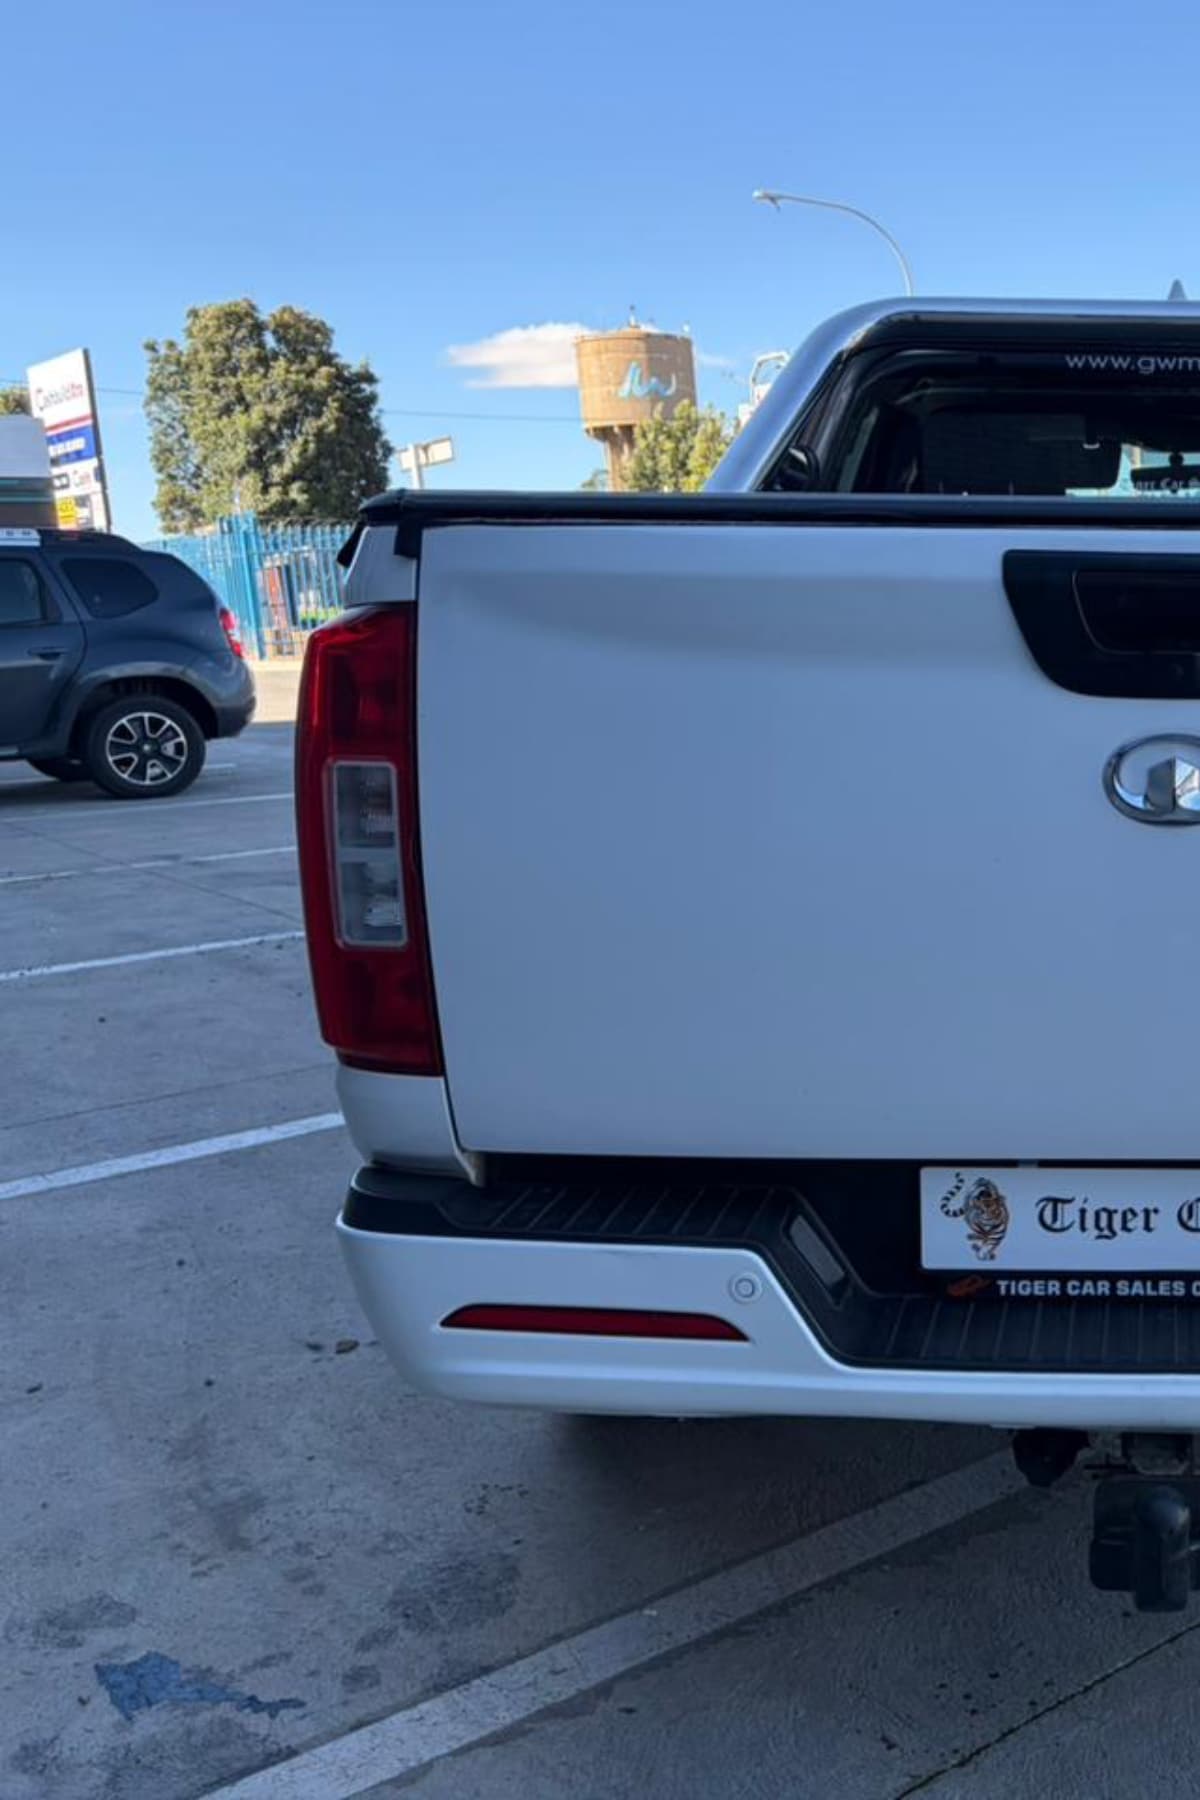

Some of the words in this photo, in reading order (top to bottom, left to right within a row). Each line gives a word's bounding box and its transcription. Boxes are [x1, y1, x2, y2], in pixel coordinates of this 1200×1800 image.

[1035, 1196, 1160, 1240] Tiger
[996, 1279, 1061, 1296] TIGER
[1066, 1279, 1112, 1296] CAR
[1116, 1279, 1186, 1296] SALES
